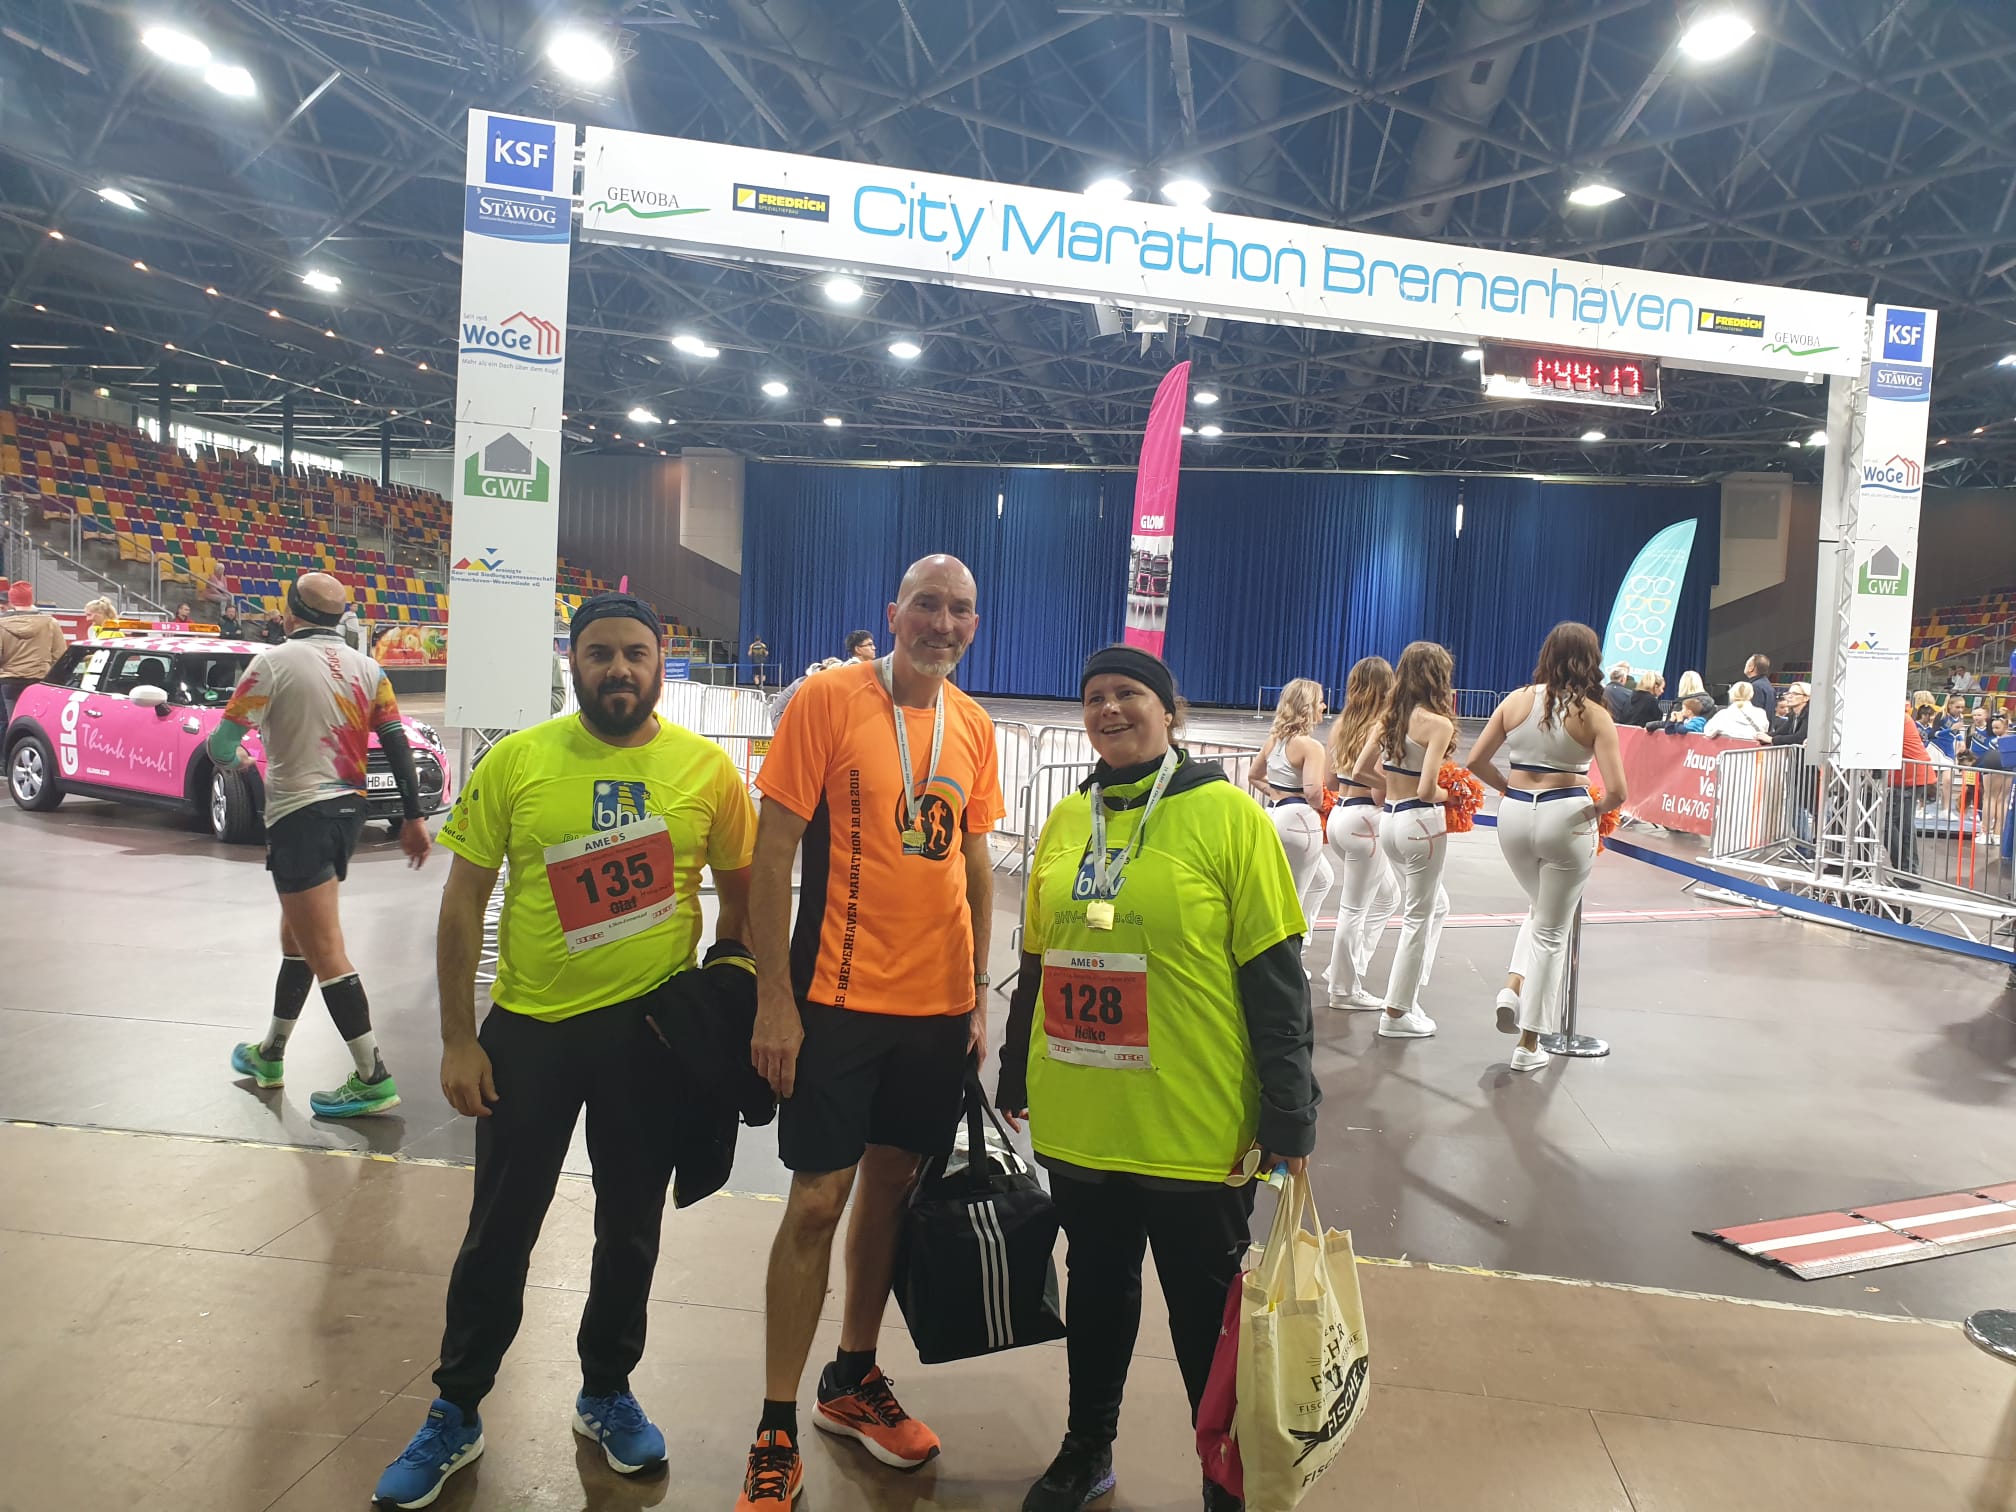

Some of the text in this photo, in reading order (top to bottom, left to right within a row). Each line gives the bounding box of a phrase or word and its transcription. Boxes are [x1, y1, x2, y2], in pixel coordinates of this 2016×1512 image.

[494, 138, 549, 168] KSF
[479, 196, 557, 224] STÄWOG
[607, 186, 680, 208] GEWOBA
[853, 182, 1694, 334] City Marathon Bremerhaven
[462, 323, 532, 350] WoGe
[1774, 332, 1811, 347] GEWOBA
[1888, 323, 1922, 345] KSF
[1536, 357, 1640, 396] 1:44:17
[1877, 369, 1923, 386] STÄWOG
[481, 477, 533, 499] GWF
[1863, 466, 1904, 484] WoGe
[1868, 580, 1899, 594] GWF
[81, 723, 174, 778] Think pink!
[367, 776, 381, 787] HB
[1661, 793, 1712, 820] Tel 04706
[576, 852, 654, 904] 135
[837, 902, 858, 991] BREMERHAVEN
[848, 831, 862, 900] MARATHON
[1060, 982, 1123, 1025] 128
